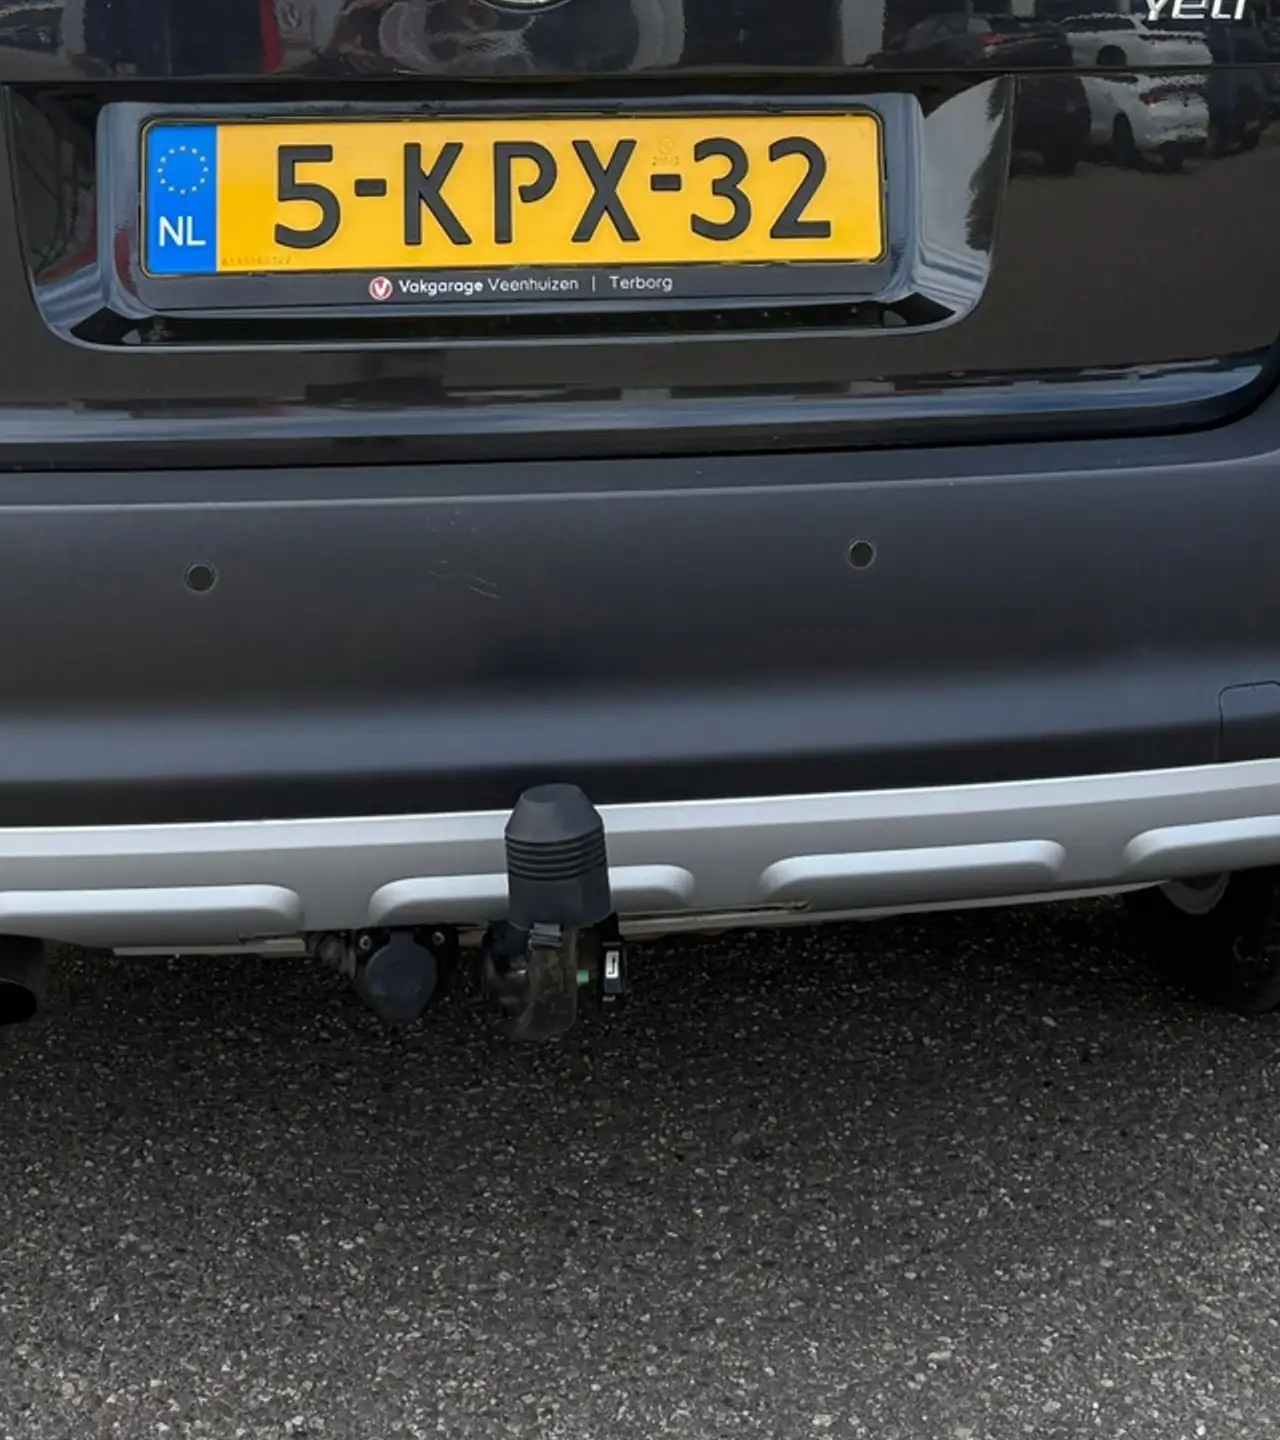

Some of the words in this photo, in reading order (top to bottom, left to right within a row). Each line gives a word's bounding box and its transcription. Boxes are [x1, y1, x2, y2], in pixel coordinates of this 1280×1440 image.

[273, 137, 832, 249] 5-KPX-32
[157, 215, 207, 248] NL
[398, 279, 483, 297] Vakgarage
[487, 276, 579, 292] Veenhuizen
[609, 275, 673, 292] Terborg
